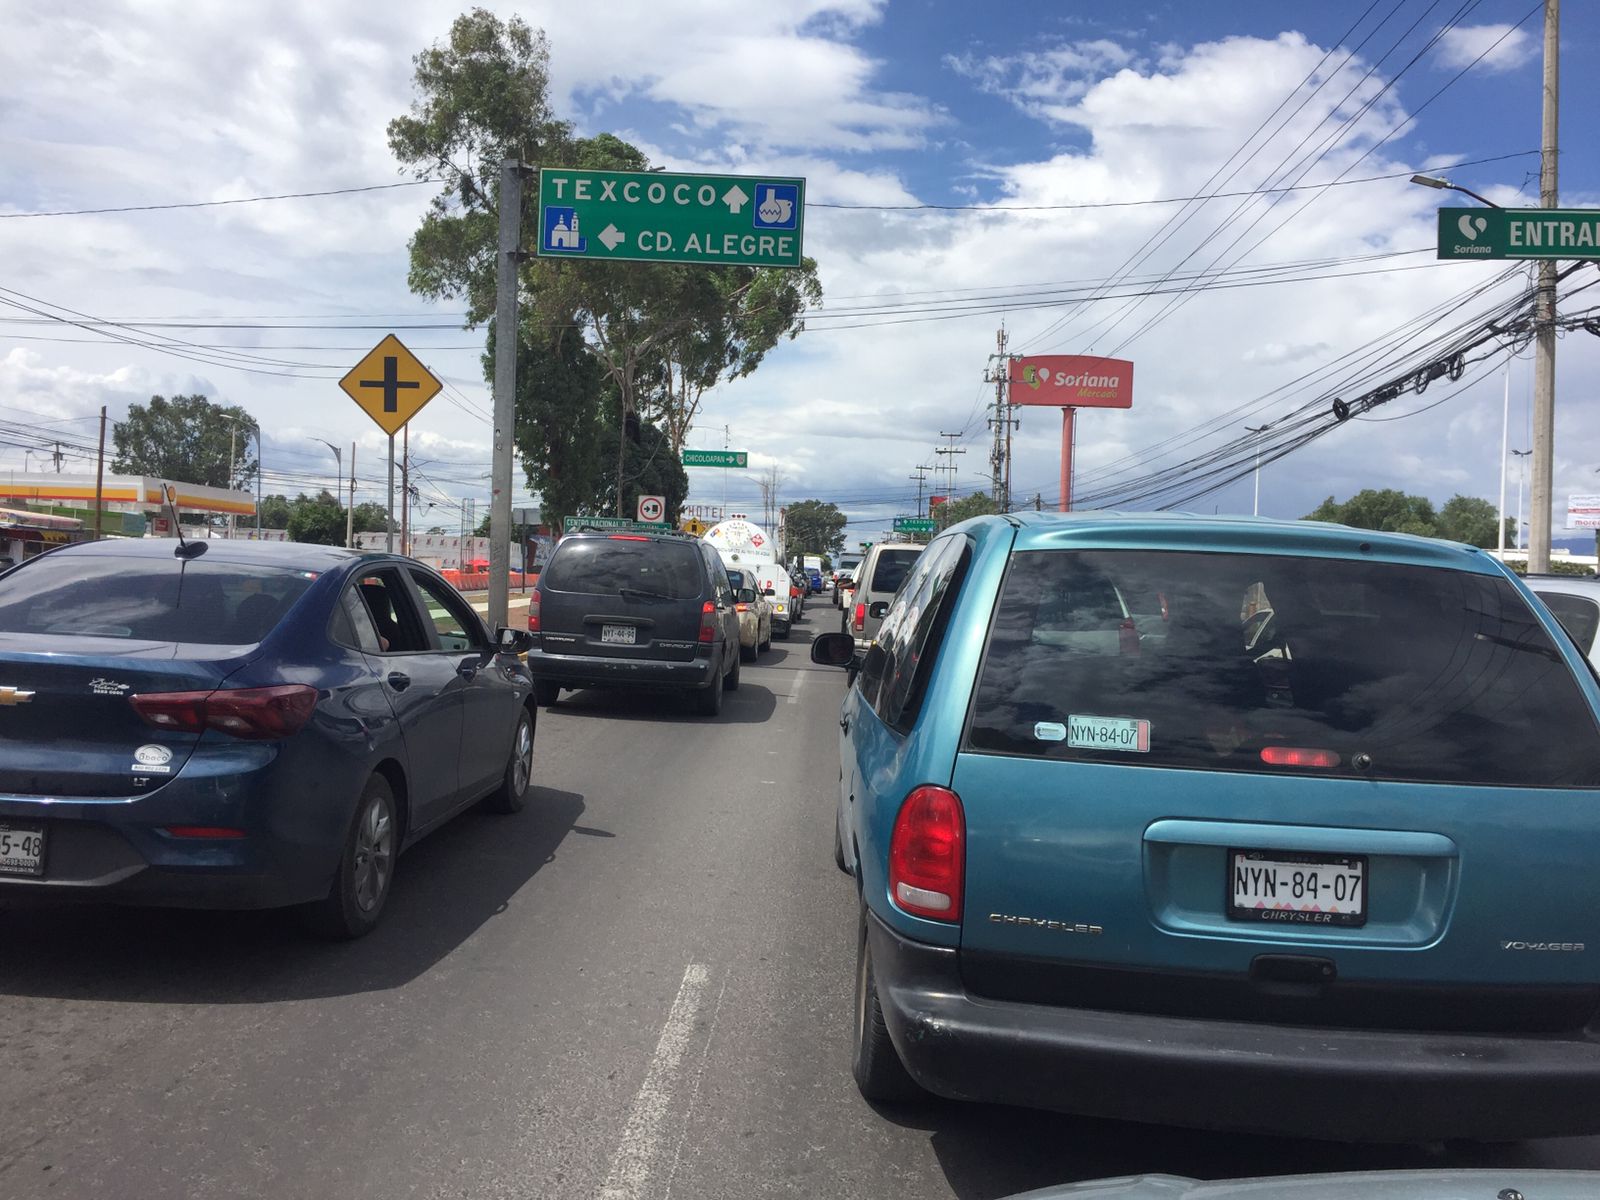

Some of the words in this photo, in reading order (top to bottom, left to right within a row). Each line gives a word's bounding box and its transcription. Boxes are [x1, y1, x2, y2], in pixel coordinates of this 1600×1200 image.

[552, 178, 716, 206] TEXCOCO
[1510, 221, 1600, 247] ENTRA
[637, 231, 677, 252] CD.
[684, 233, 793, 258] ALEGRE
[1453, 244, 1492, 254] Soriana
[1054, 372, 1119, 388] Soriana
[1077, 387, 1117, 398] Mercado
[685, 454, 725, 463] CHICOLOAPAN
[688, 505, 724, 519] HOTEL
[1071, 725, 1136, 745] NYN-84-07
[0, 835, 41, 857] 5-48
[1236, 867, 1361, 901] NYN-84-07
[990, 913, 1103, 934] CHRYSLER
[1261, 910, 1332, 923] CHRYSLER
[1501, 941, 1584, 951] VOYAGER
